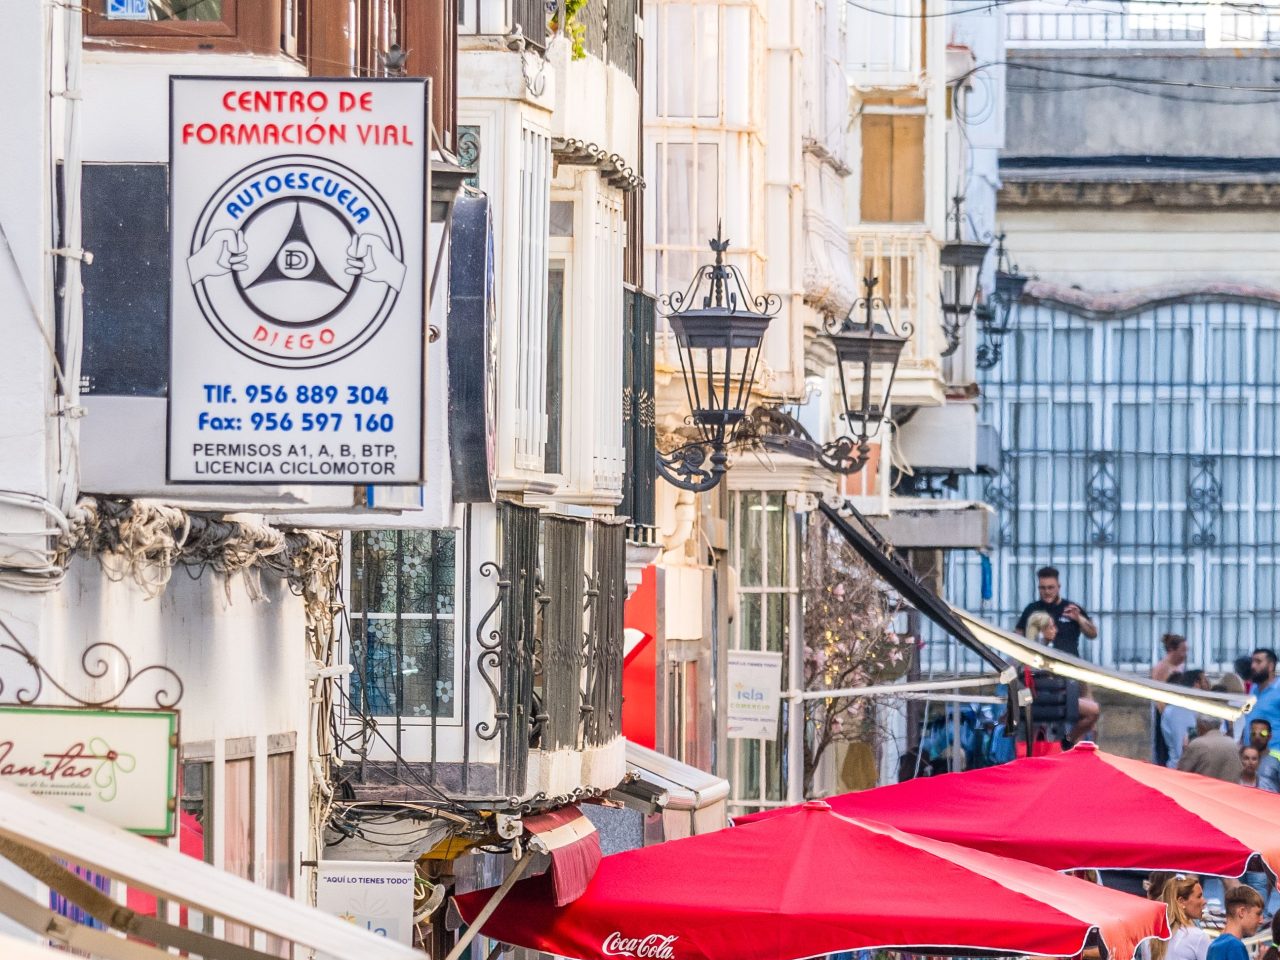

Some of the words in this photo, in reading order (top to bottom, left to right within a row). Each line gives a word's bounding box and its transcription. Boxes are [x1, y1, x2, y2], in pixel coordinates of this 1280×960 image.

[222, 90, 329, 113] CENTRO
[339, 91, 373, 112] DE
[182, 117, 347, 145] FORMACIÓN
[356, 124, 414, 146] VIAL
[226, 172, 371, 224] AUTOESCUELA
[253, 325, 335, 350] DIEGO
[203, 384, 237, 403] Tlf.
[245, 384, 288, 404] 956
[296, 385, 338, 405] 889
[346, 385, 389, 405] 304
[198, 412, 242, 431] Fax:
[250, 412, 293, 431] 956
[301, 413, 343, 432] 597
[354, 413, 394, 432] 160
[193, 443, 282, 457] PERMISOS
[287, 444, 313, 458] A1,
[318, 444, 334, 459] A,
[340, 444, 356, 459] B,
[362, 444, 397, 459] BTP,
[195, 461, 275, 475] LICENCIA
[280, 461, 396, 475] CICLOMOTOR
